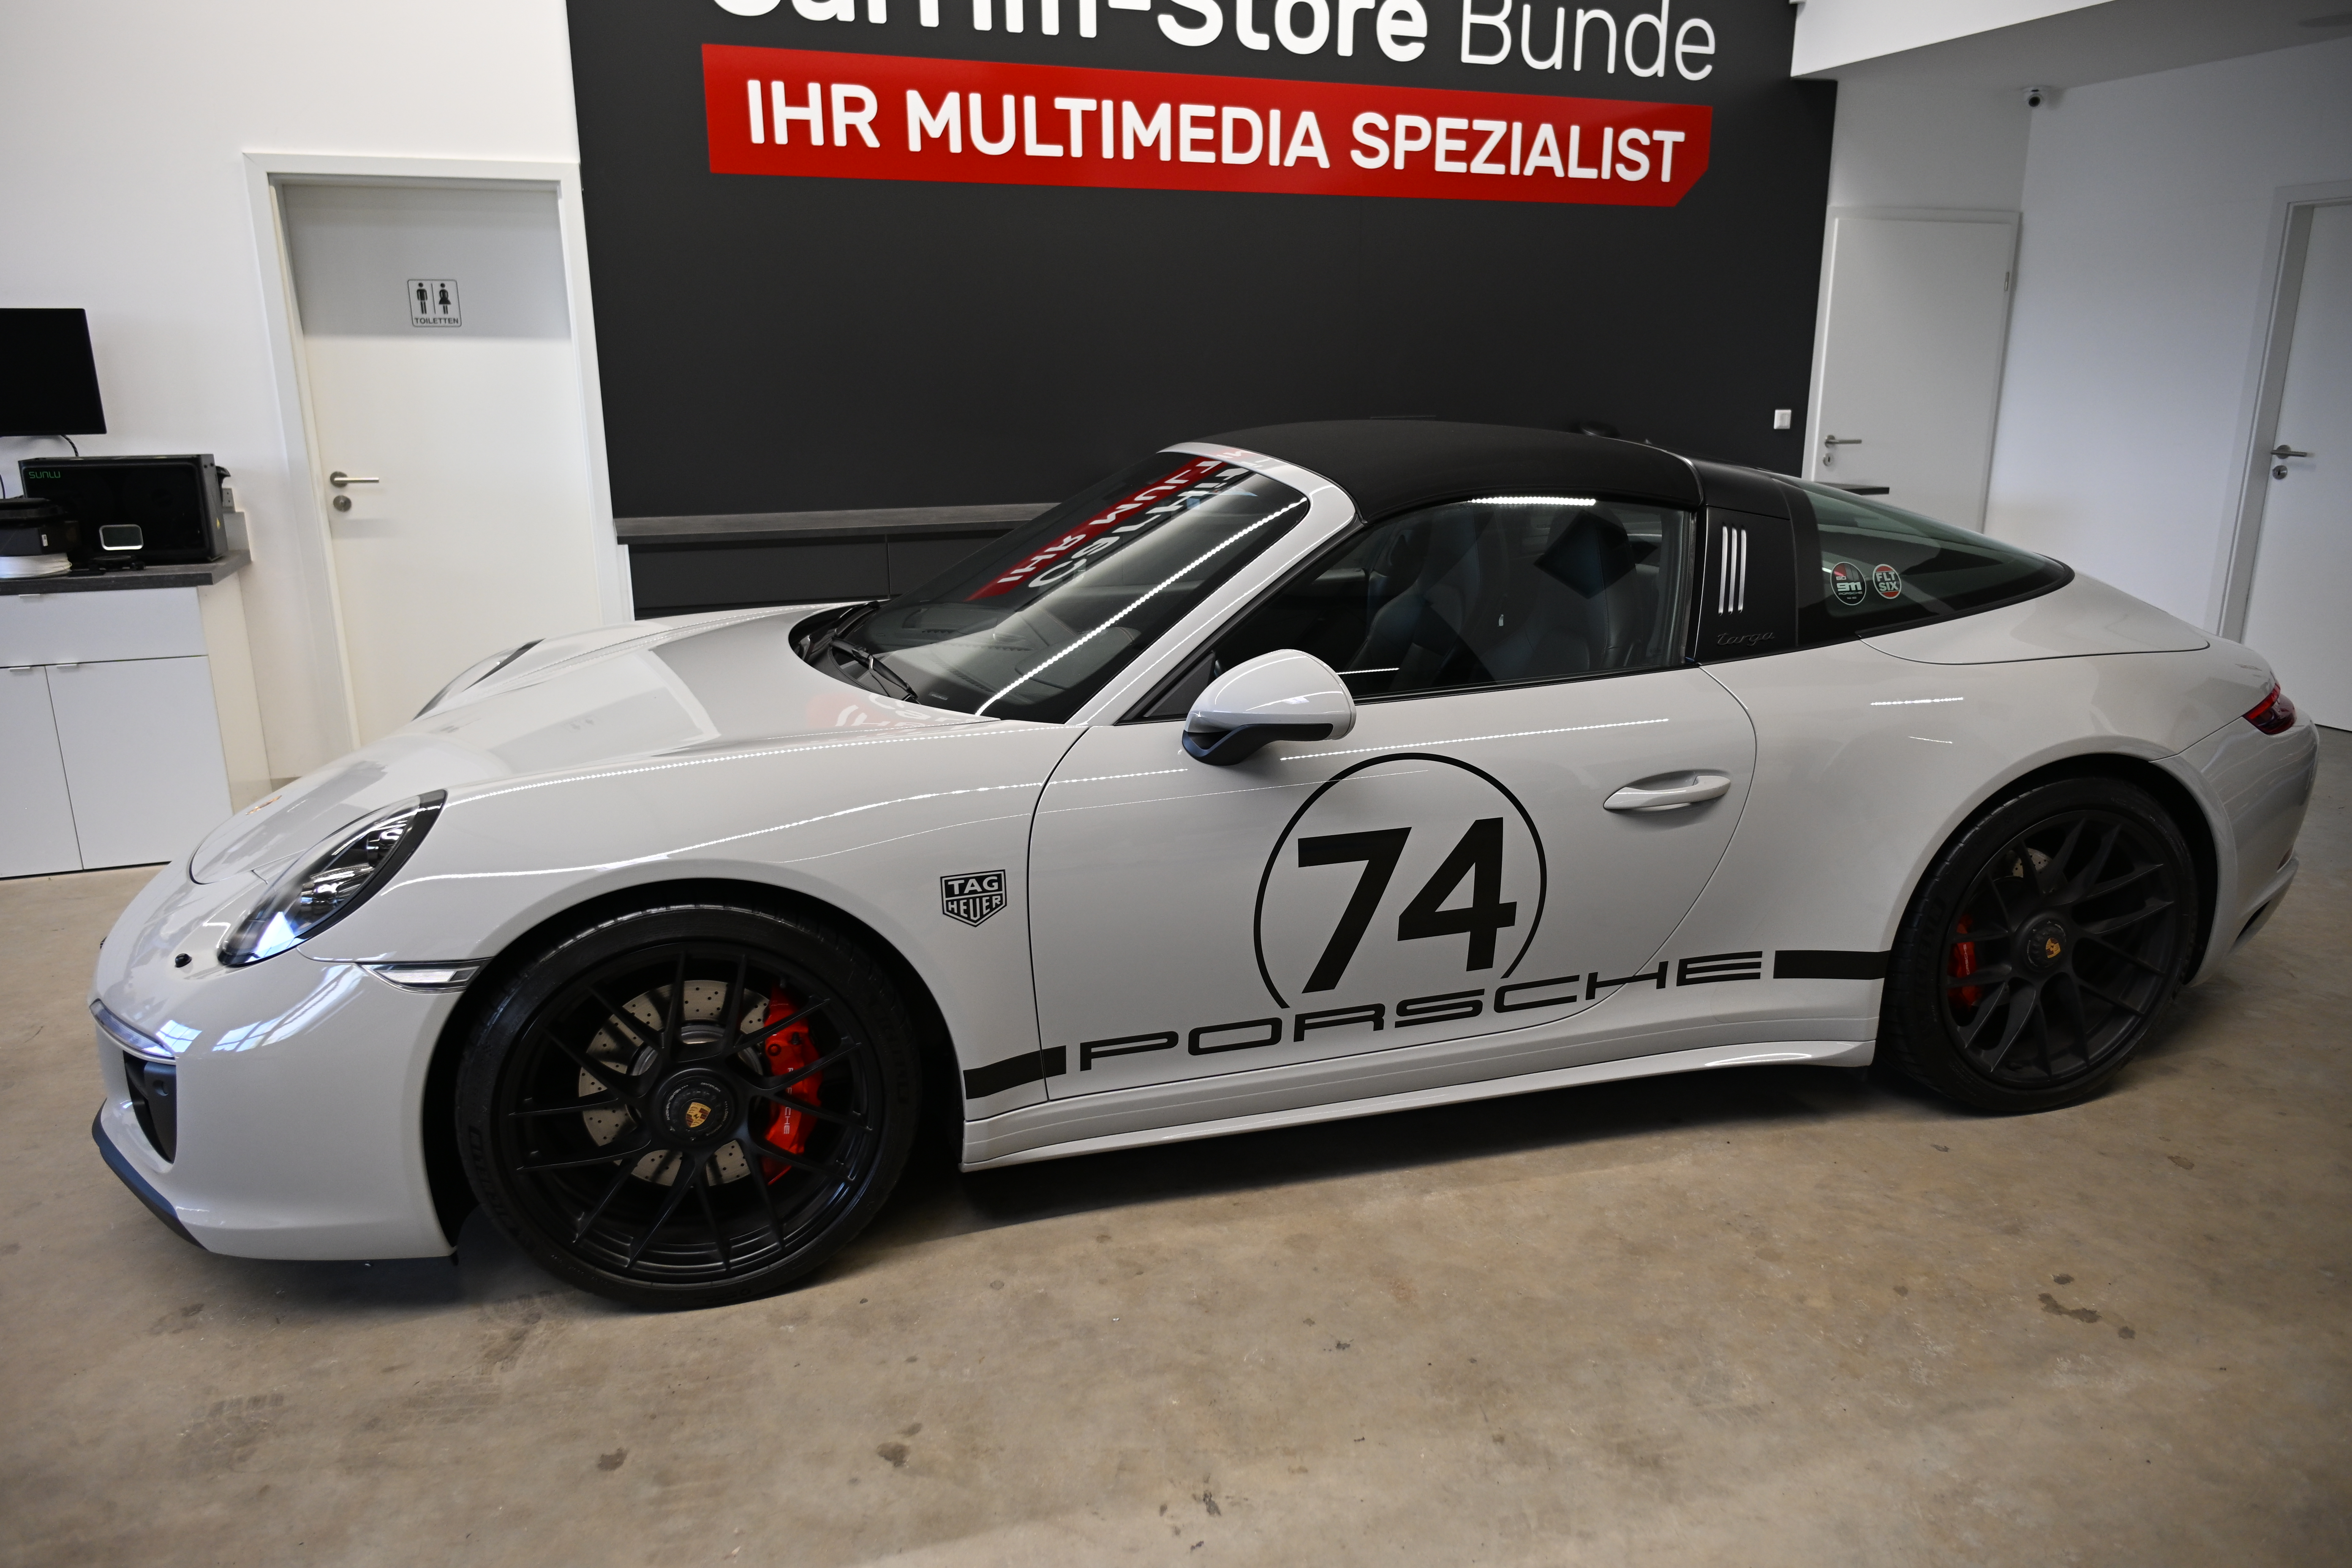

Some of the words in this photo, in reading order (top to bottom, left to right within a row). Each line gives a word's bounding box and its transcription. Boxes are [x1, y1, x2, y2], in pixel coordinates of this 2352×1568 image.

[747, 79, 880, 148] IHR
[906, 89, 1330, 169] MULTIMEDIA
[1350, 112, 1685, 182] SPEZIALIST
[1836, 582, 1862, 591] 911
[1876, 572, 1895, 582] FLT
[1878, 581, 1899, 591] SIX
[948, 876, 999, 895] TAG
[948, 896, 1001, 921] HEUER
[1298, 817, 1517, 994] 74
[1080, 951, 1763, 1071] PORSCHE
